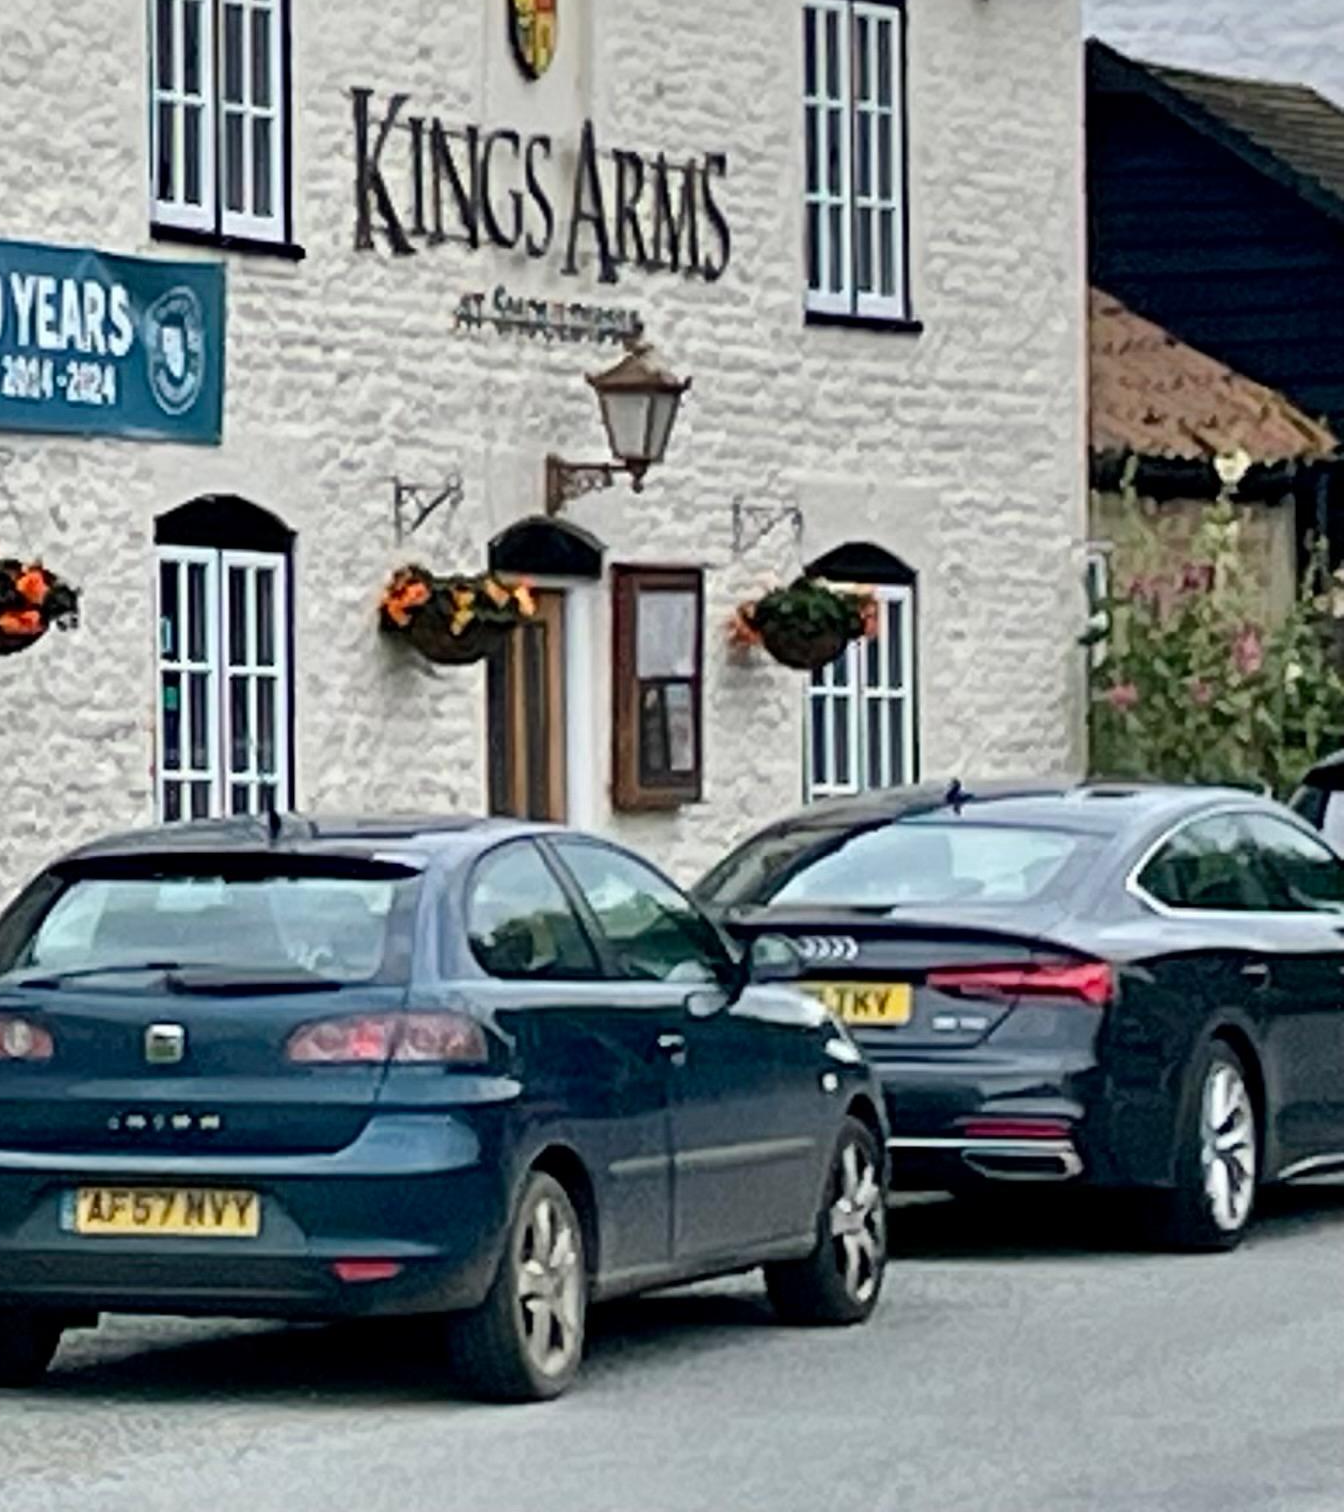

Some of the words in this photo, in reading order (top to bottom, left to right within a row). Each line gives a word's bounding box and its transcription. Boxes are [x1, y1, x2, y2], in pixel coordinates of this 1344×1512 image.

[350, 88, 553, 258] KINGS
[561, 119, 732, 284] ARMS
[10, 273, 134, 356] YEARS
